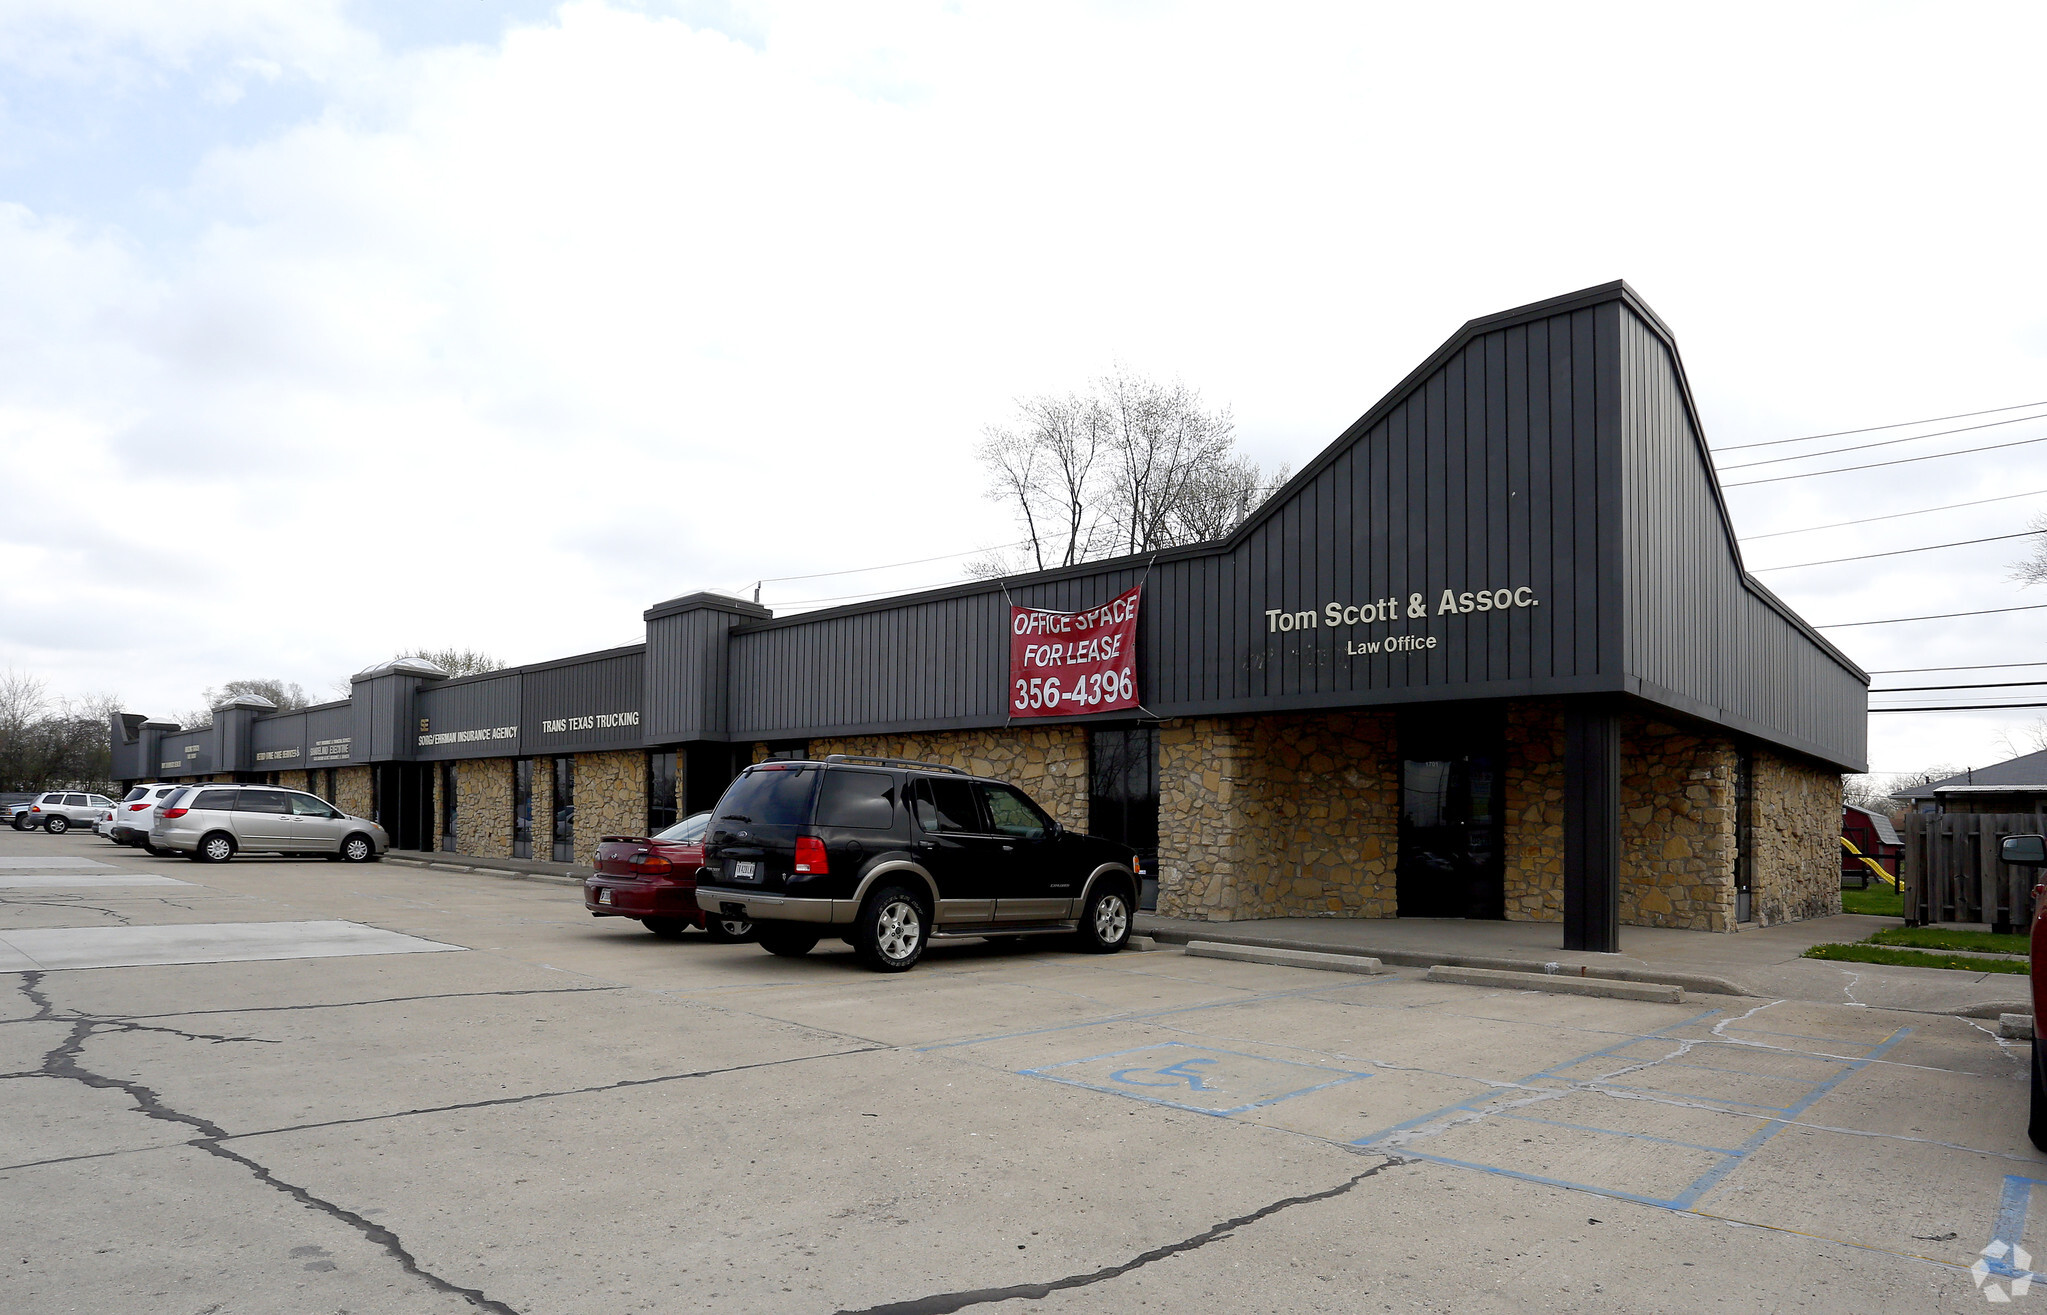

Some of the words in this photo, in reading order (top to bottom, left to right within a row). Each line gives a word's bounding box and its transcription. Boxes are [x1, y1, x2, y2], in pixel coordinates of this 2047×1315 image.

[1014, 613, 1071, 635] OFFICE
[1075, 595, 1138, 630] SPACE
[1265, 609, 1317, 633] Tom
[1324, 597, 1398, 627] Scott
[1407, 592, 1427, 619] &
[1438, 586, 1539, 616] Assoc.
[1024, 643, 1064, 667] FOR
[1066, 633, 1122, 665] LEASE
[1347, 640, 1380, 655] Law
[1384, 635, 1437, 652] Office
[1014, 667, 1133, 710] 356-4396
[457, 728, 491, 742] INSURANCE
[491, 725, 518, 740] AGENCY
[542, 719, 566, 733] TRANS
[568, 715, 593, 731] TEXAS
[595, 711, 639, 728] TRUCKING
